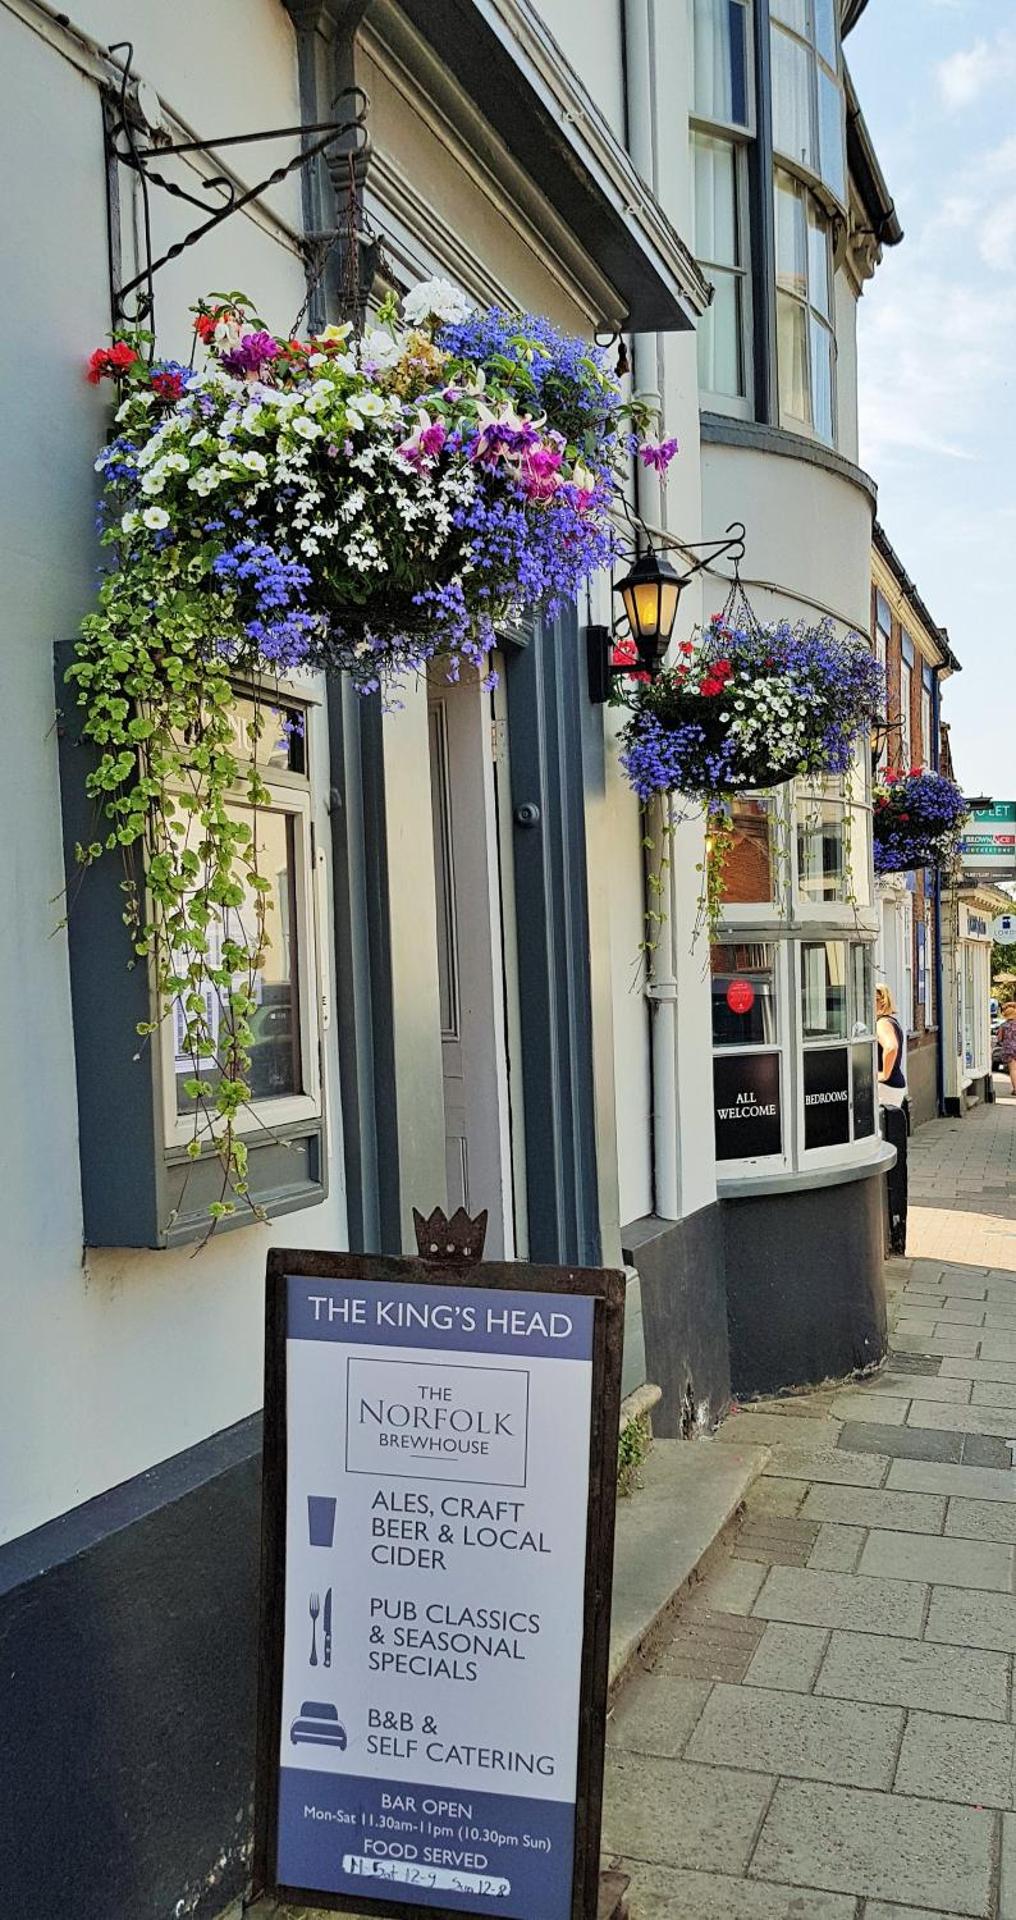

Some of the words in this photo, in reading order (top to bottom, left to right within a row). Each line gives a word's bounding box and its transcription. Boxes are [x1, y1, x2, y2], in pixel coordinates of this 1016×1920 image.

[717, 1104, 776, 1120] WELCOME
[736, 1092, 756, 1104] ALL
[805, 1090, 848, 1106] BEDROOMS
[308, 1296, 366, 1324] THE
[376, 1301, 477, 1332] KING’S
[487, 1309, 573, 1338] HEAD
[418, 1385, 452, 1401] THE
[359, 1398, 514, 1437] NORFOLK
[379, 1433, 489, 1455] BREWHOUSE
[371, 1490, 434, 1517] ALES,
[440, 1496, 525, 1523] CRAFT
[371, 1518, 430, 1542] BEER
[438, 1524, 455, 1545] &
[463, 1527, 552, 1554] LOCAL
[371, 1545, 447, 1571] CIDER
[370, 1598, 417, 1621] PUB
[426, 1604, 540, 1634] CLASSICS
[369, 1625, 386, 1645] &
[393, 1628, 526, 1660] SEASONAL
[368, 1652, 478, 1682] SPECIALS
[367, 1709, 415, 1732] B&B
[421, 1716, 438, 1735] &
[366, 1736, 418, 1758] SELF
[426, 1743, 556, 1776] CATERING
[381, 1793, 417, 1812] BAR
[422, 1799, 473, 1820] OPEN
[303, 1805, 357, 1825] Mon-Sat
[361, 1812, 454, 1838] 11.30am-11pm
[458, 1824, 518, 1848] (10.30pm
[522, 1834, 552, 1853] Sun)
[363, 1839, 418, 1860] FOOD
[423, 1847, 489, 1870] SERVED
